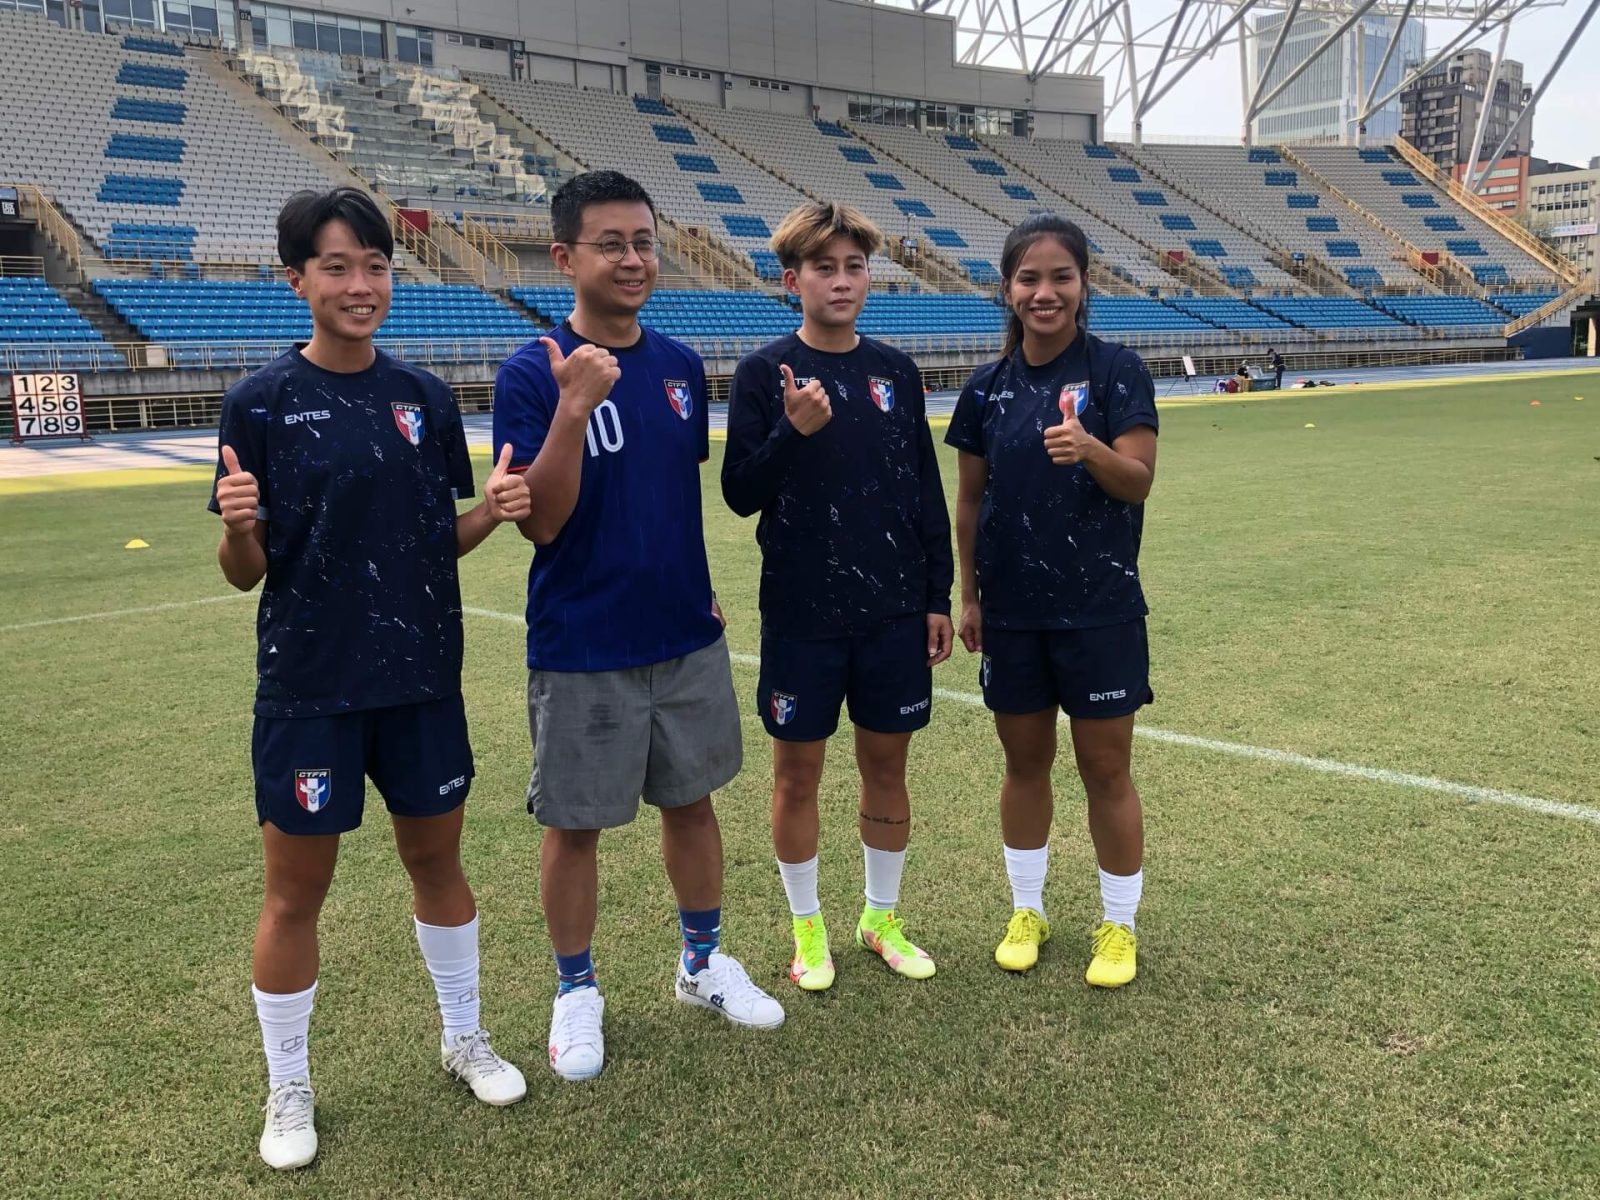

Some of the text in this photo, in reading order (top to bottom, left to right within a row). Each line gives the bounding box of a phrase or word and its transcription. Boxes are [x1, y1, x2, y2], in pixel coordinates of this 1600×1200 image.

[18, 375, 76, 392] 1 2 3
[18, 395, 78, 413] 4 5 6
[988, 390, 1015, 402] ENES
[395, 403, 421, 413] CTFA
[21, 415, 81, 434] 7 8 9
[284, 409, 331, 425] ENTES
[1089, 688, 1127, 702] ENTES
[899, 697, 929, 715] ENTES
[298, 770, 328, 778] CTFA
[438, 774, 465, 796] ENTES
